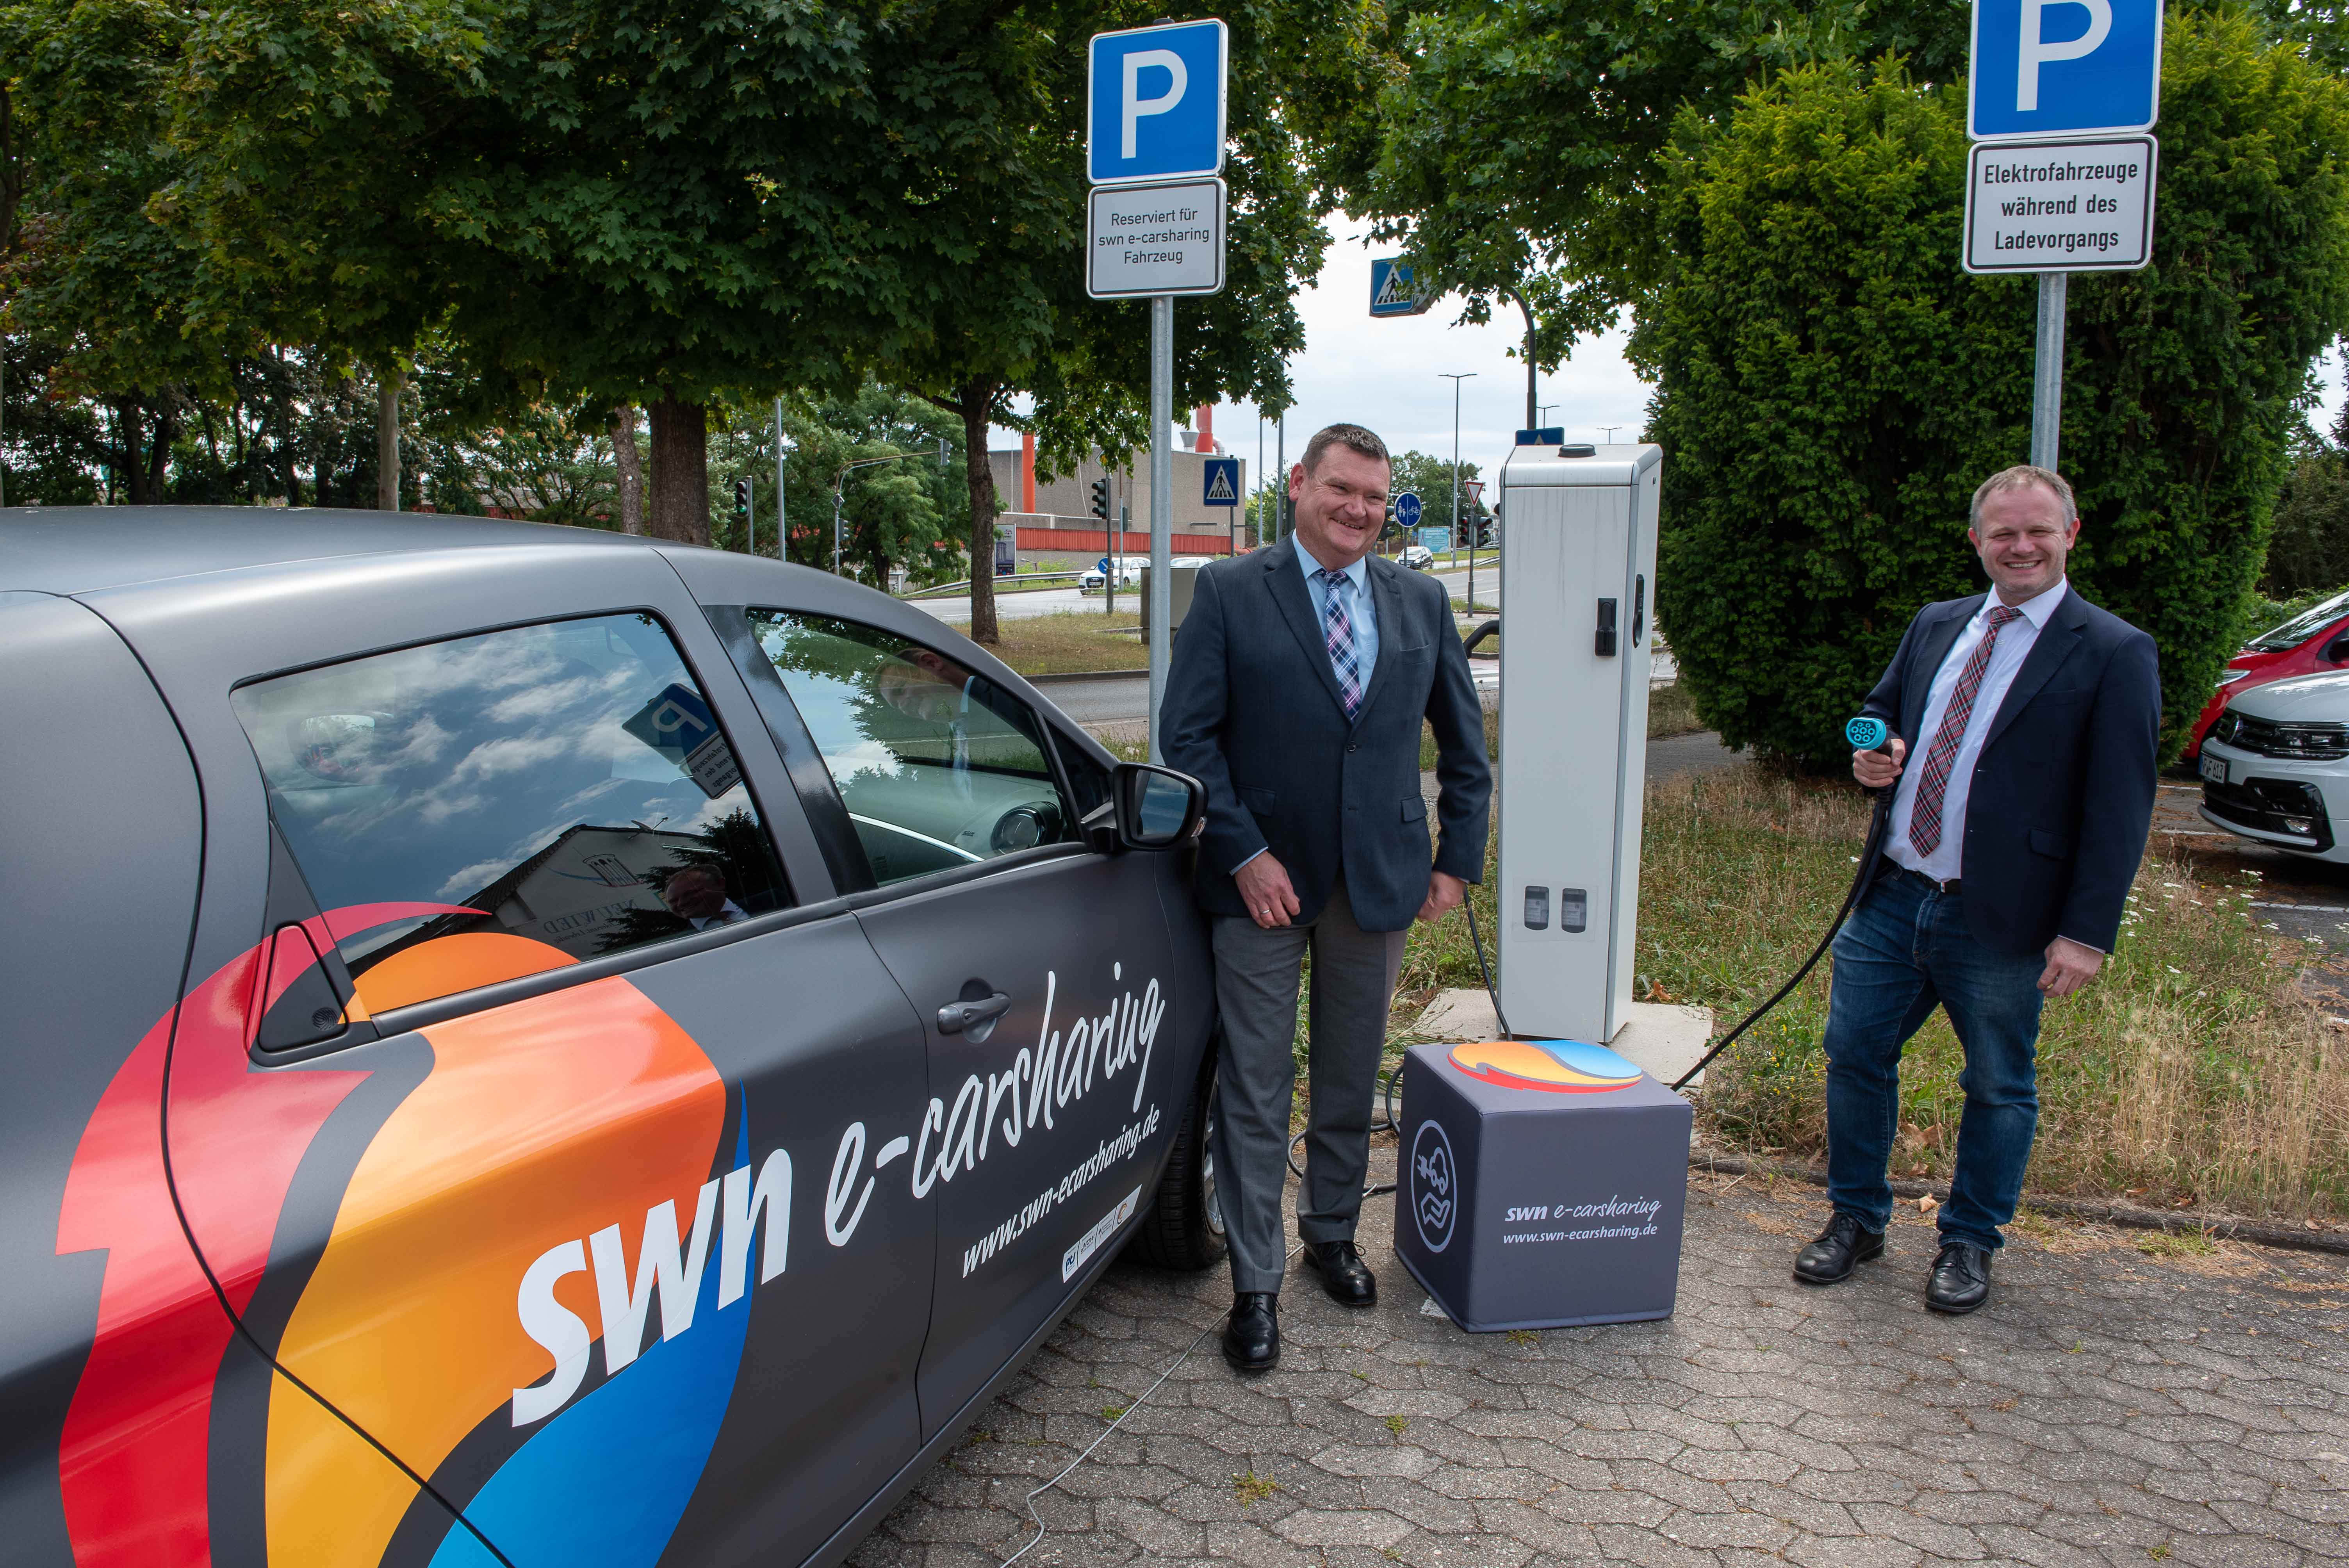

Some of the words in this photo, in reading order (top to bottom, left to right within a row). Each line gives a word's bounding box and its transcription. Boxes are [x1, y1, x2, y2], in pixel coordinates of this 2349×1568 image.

[2017, 0, 2112, 112] P
[1121, 49, 1187, 159] P
[1984, 162, 2138, 184] Elektrofahrzeuge
[2001, 195, 2076, 216] während
[2086, 194, 2117, 214] des
[1111, 210, 1175, 226] Reserviert
[1179, 208, 1198, 221] für
[1099, 235, 1124, 246] swn
[1128, 228, 1209, 244] e-carsharing
[1995, 230, 2119, 252] Ladevorgangs
[1124, 250, 1183, 264] Fahrzeug
[512, 1149, 792, 1427] swn
[825, 962, 1165, 1247] e-carsharing
[963, 1103, 1160, 1278] www.swn-ecarsharing.de
[1505, 1206, 1547, 1222] swn
[1554, 1194, 1662, 1221] e-carsharing
[1503, 1223, 1658, 1244] www.swn-ecarsharing.de
